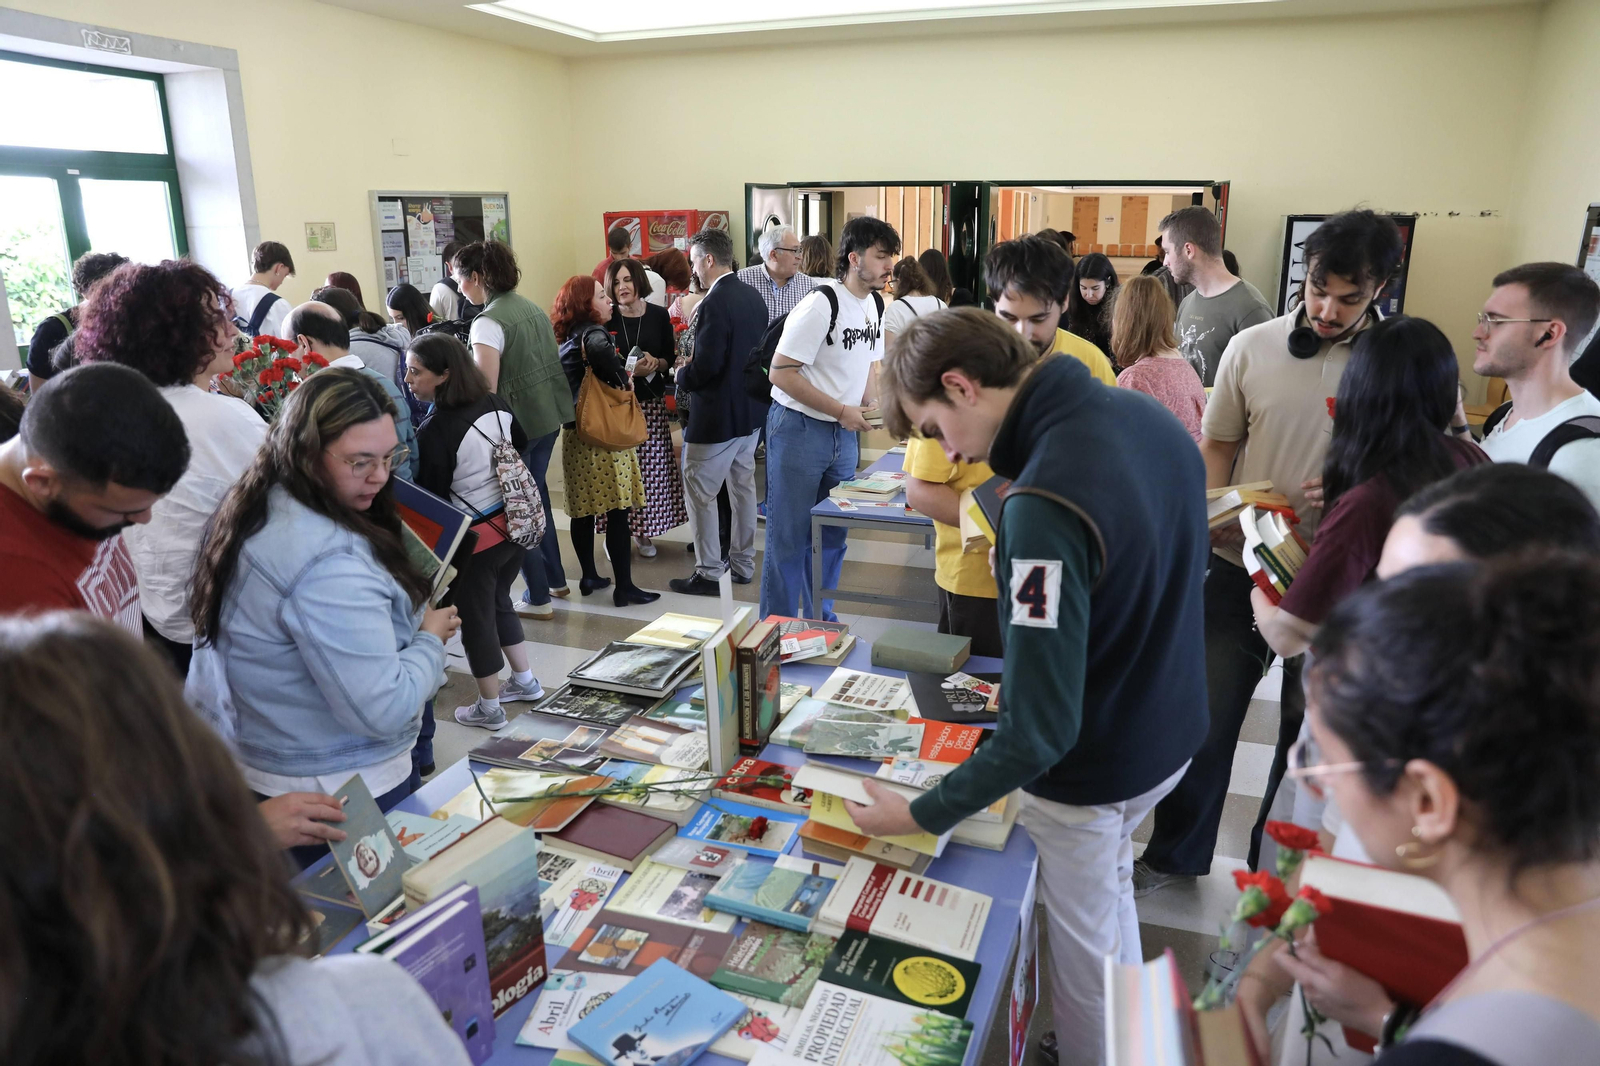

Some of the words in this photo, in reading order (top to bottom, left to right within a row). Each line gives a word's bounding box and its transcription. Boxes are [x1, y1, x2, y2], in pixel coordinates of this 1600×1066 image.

[649, 220, 687, 237] Coca-Cola
[1016, 566, 1047, 619] 4
[944, 739, 955, 748] de
[954, 729, 970, 749] cerdos
[726, 758, 757, 785] cbra
[589, 864, 615, 877] Abril
[726, 935, 756, 967] Helechos
[538, 1000, 565, 1036] Abril
[809, 992, 829, 1024] NEGOCIO
[824, 989, 832, 997] Y
[804, 990, 848, 1063] PROPIEDAD
[822, 997, 862, 1066] INTELECTUAL
